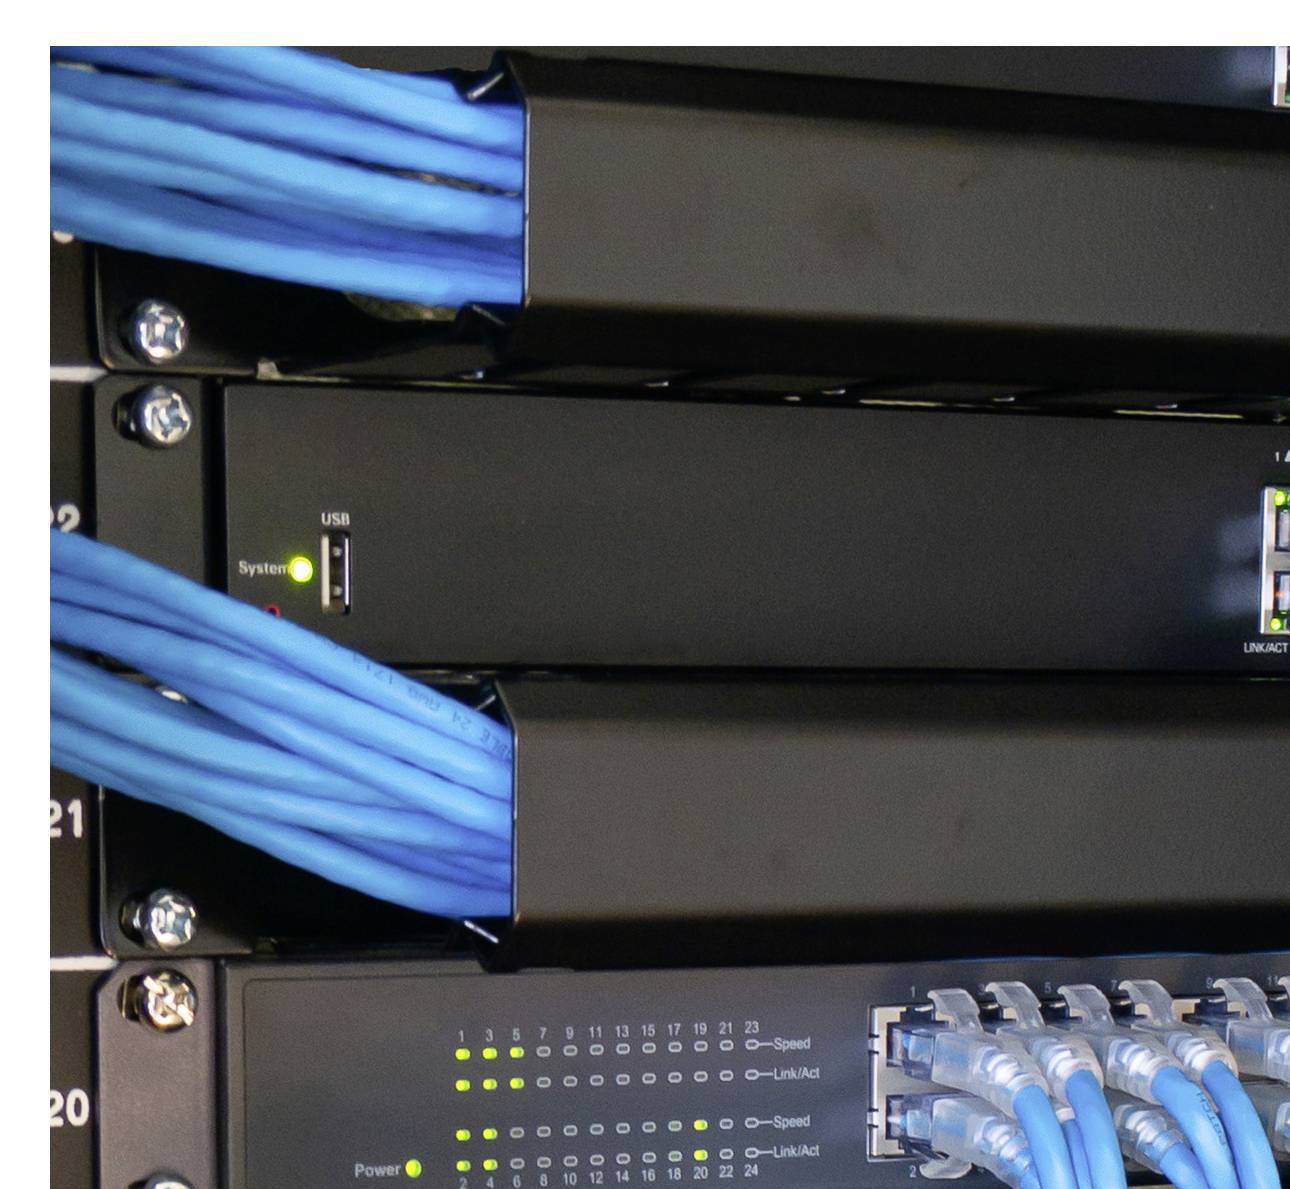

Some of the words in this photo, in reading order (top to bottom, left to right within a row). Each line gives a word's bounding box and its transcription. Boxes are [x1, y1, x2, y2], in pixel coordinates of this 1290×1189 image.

[50, 504, 80, 532] 2
[321, 512, 350, 526] USB
[1243, 642, 1288, 653] LINK/ACT
[50, 798, 82, 838] 21
[458, 1030, 464, 1042] 1
[486, 1029, 493, 1042] 3
[512, 1028, 520, 1041] 5
[539, 1027, 547, 1039] 7
[566, 1026, 574, 1040] 9
[589, 1026, 601, 1039] 11
[615, 1025, 630, 1038] 13
[641, 1024, 655, 1037] 15
[668, 1023, 681, 1036] 17
[694, 1022, 707, 1035] 19
[719, 1022, 733, 1034] 21
[745, 1021, 760, 1034] 23
[773, 1036, 811, 1052] Speed
[774, 1067, 820, 1080] Link/Act
[50, 1088, 90, 1127] 20
[773, 1115, 811, 1131] Speed
[773, 1144, 820, 1159] Link/Act
[354, 1163, 401, 1178] Power
[486, 1176, 494, 1189] 4
[513, 1175, 521, 1188] 6
[540, 1174, 548, 1187] 8
[564, 1172, 577, 1186] 10
[590, 1171, 604, 1185] 12
[616, 1170, 630, 1183] 14
[642, 1168, 656, 1182] 16
[668, 1167, 682, 1180] 18
[693, 1166, 708, 1179] 20
[719, 1165, 733, 1178] 22
[744, 1164, 759, 1177] 24
